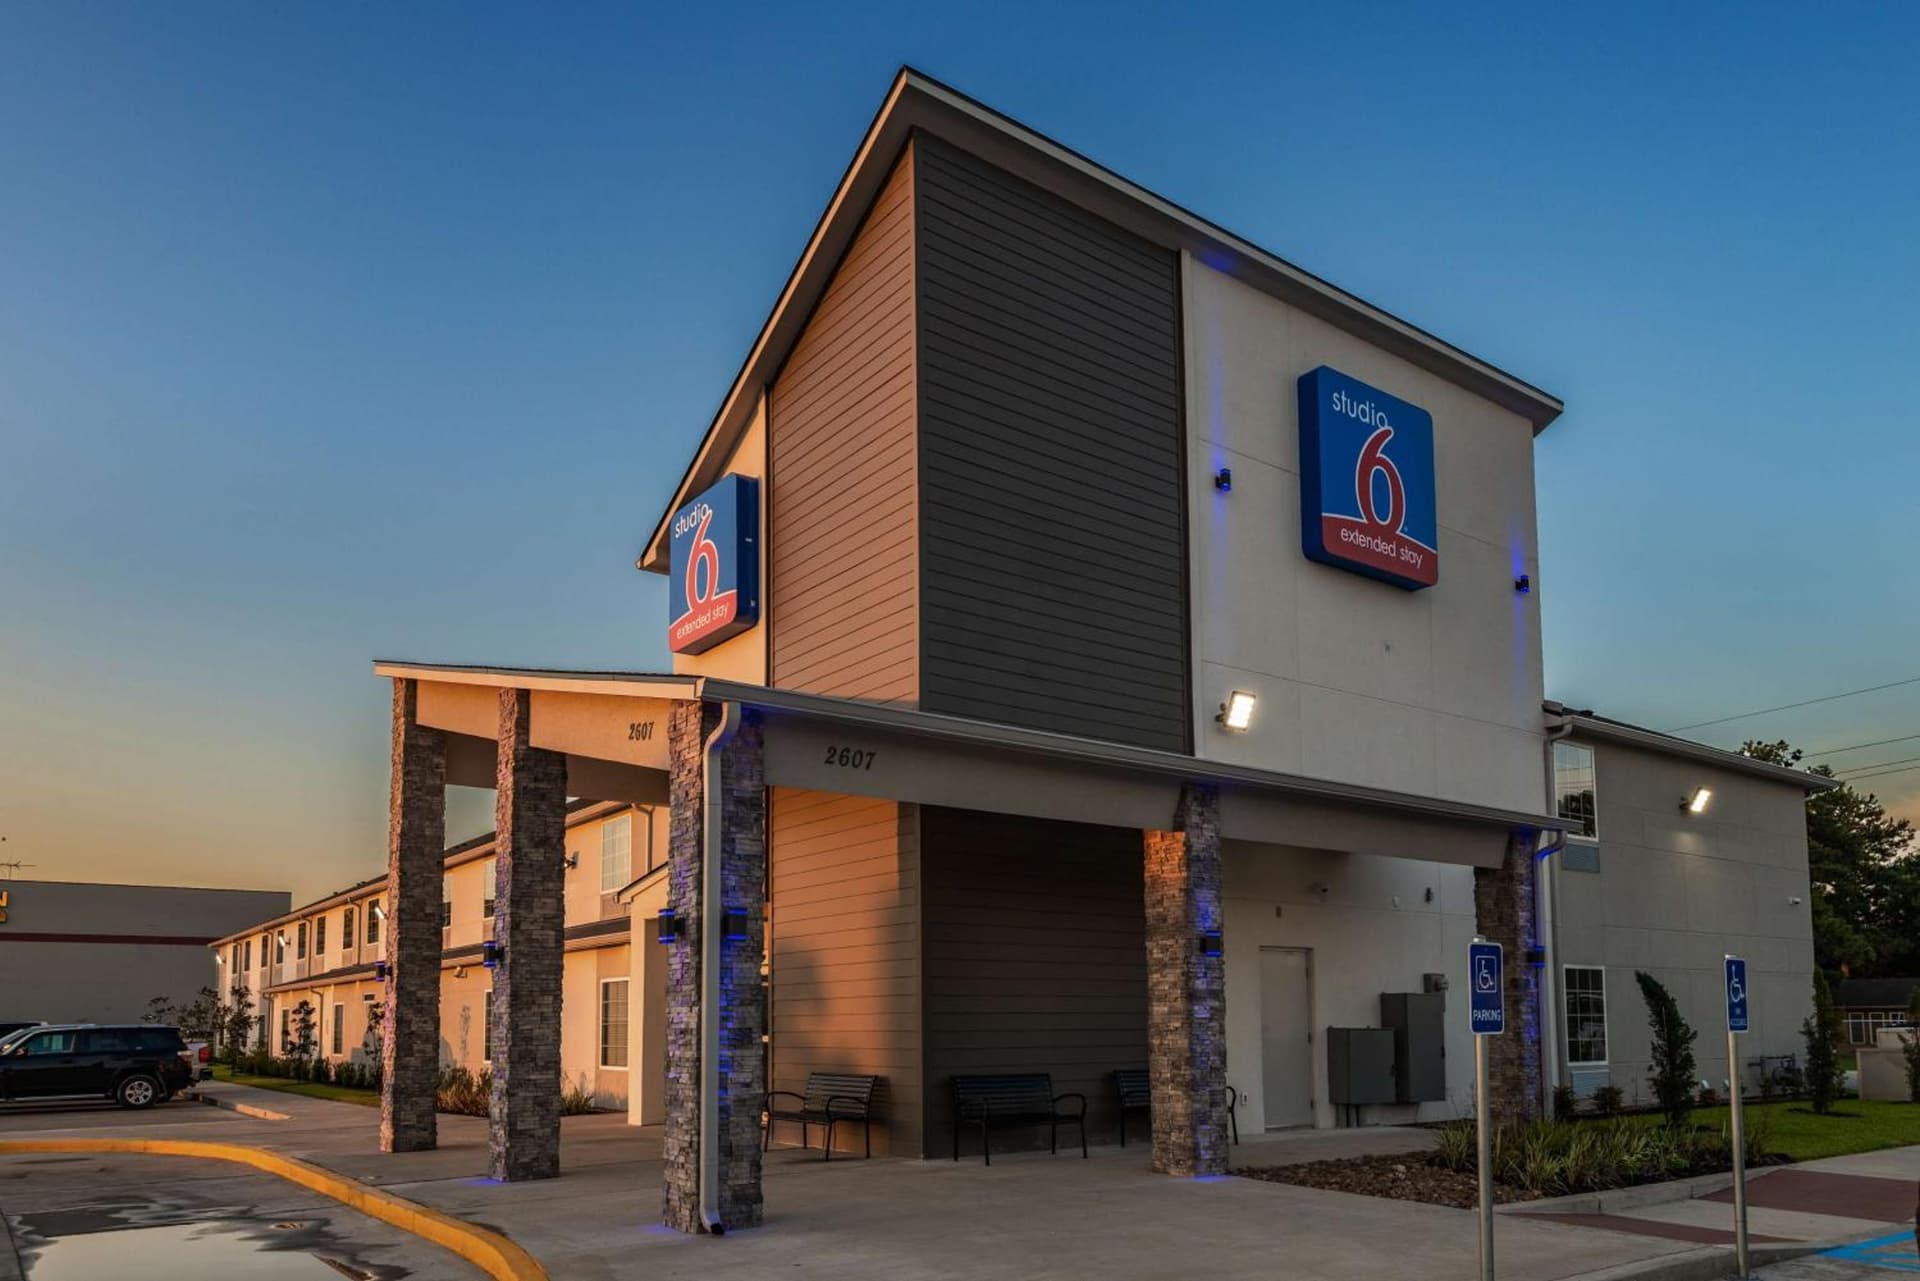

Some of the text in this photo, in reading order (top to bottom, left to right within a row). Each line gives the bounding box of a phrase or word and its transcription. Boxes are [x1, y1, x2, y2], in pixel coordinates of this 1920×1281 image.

[1332, 391, 1388, 428] studio
[1355, 426, 1406, 533] 6
[675, 503, 709, 538] studio
[685, 509, 718, 611] 6
[1340, 528, 1423, 569] extended stay
[676, 603, 729, 640] extended stay
[628, 721, 654, 741] 2607
[824, 745, 876, 771] 2607
[1473, 1009, 1501, 1022] PARKING
